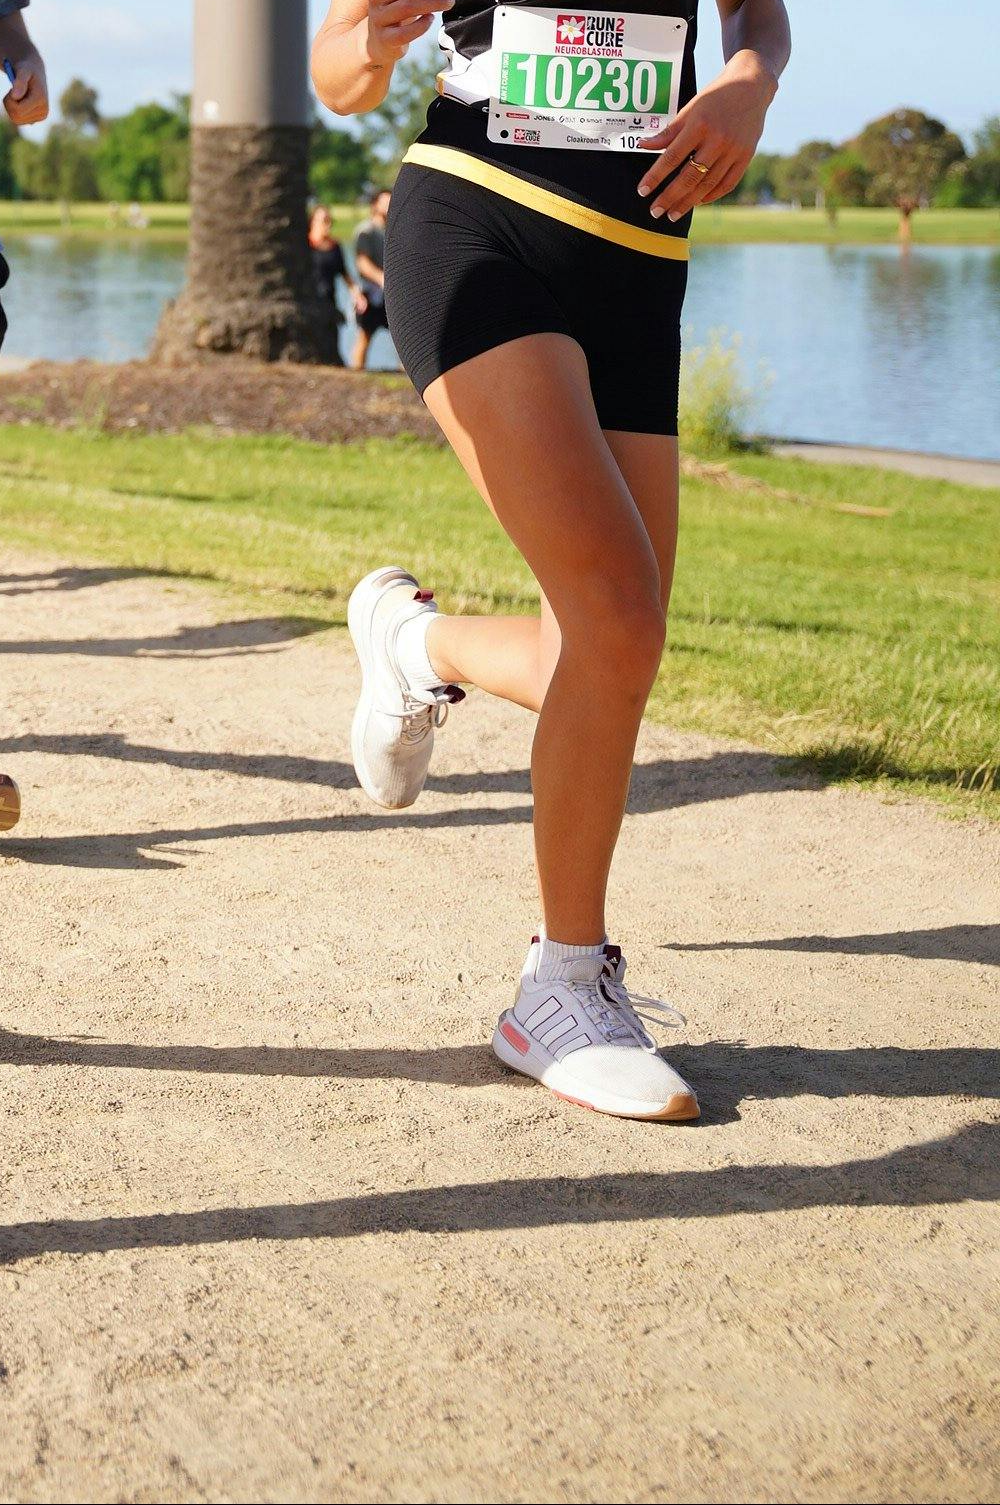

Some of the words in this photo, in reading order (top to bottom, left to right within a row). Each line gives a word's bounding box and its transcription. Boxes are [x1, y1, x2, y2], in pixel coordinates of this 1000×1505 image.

[586, 31, 624, 47] CURE
[555, 46, 623, 57] NEUROBLASTOMA
[516, 54, 658, 112] 10230
[566, 135, 600, 144] Cloakroom
[601, 137, 611, 146] Tag
[620, 136, 641, 149] 102
